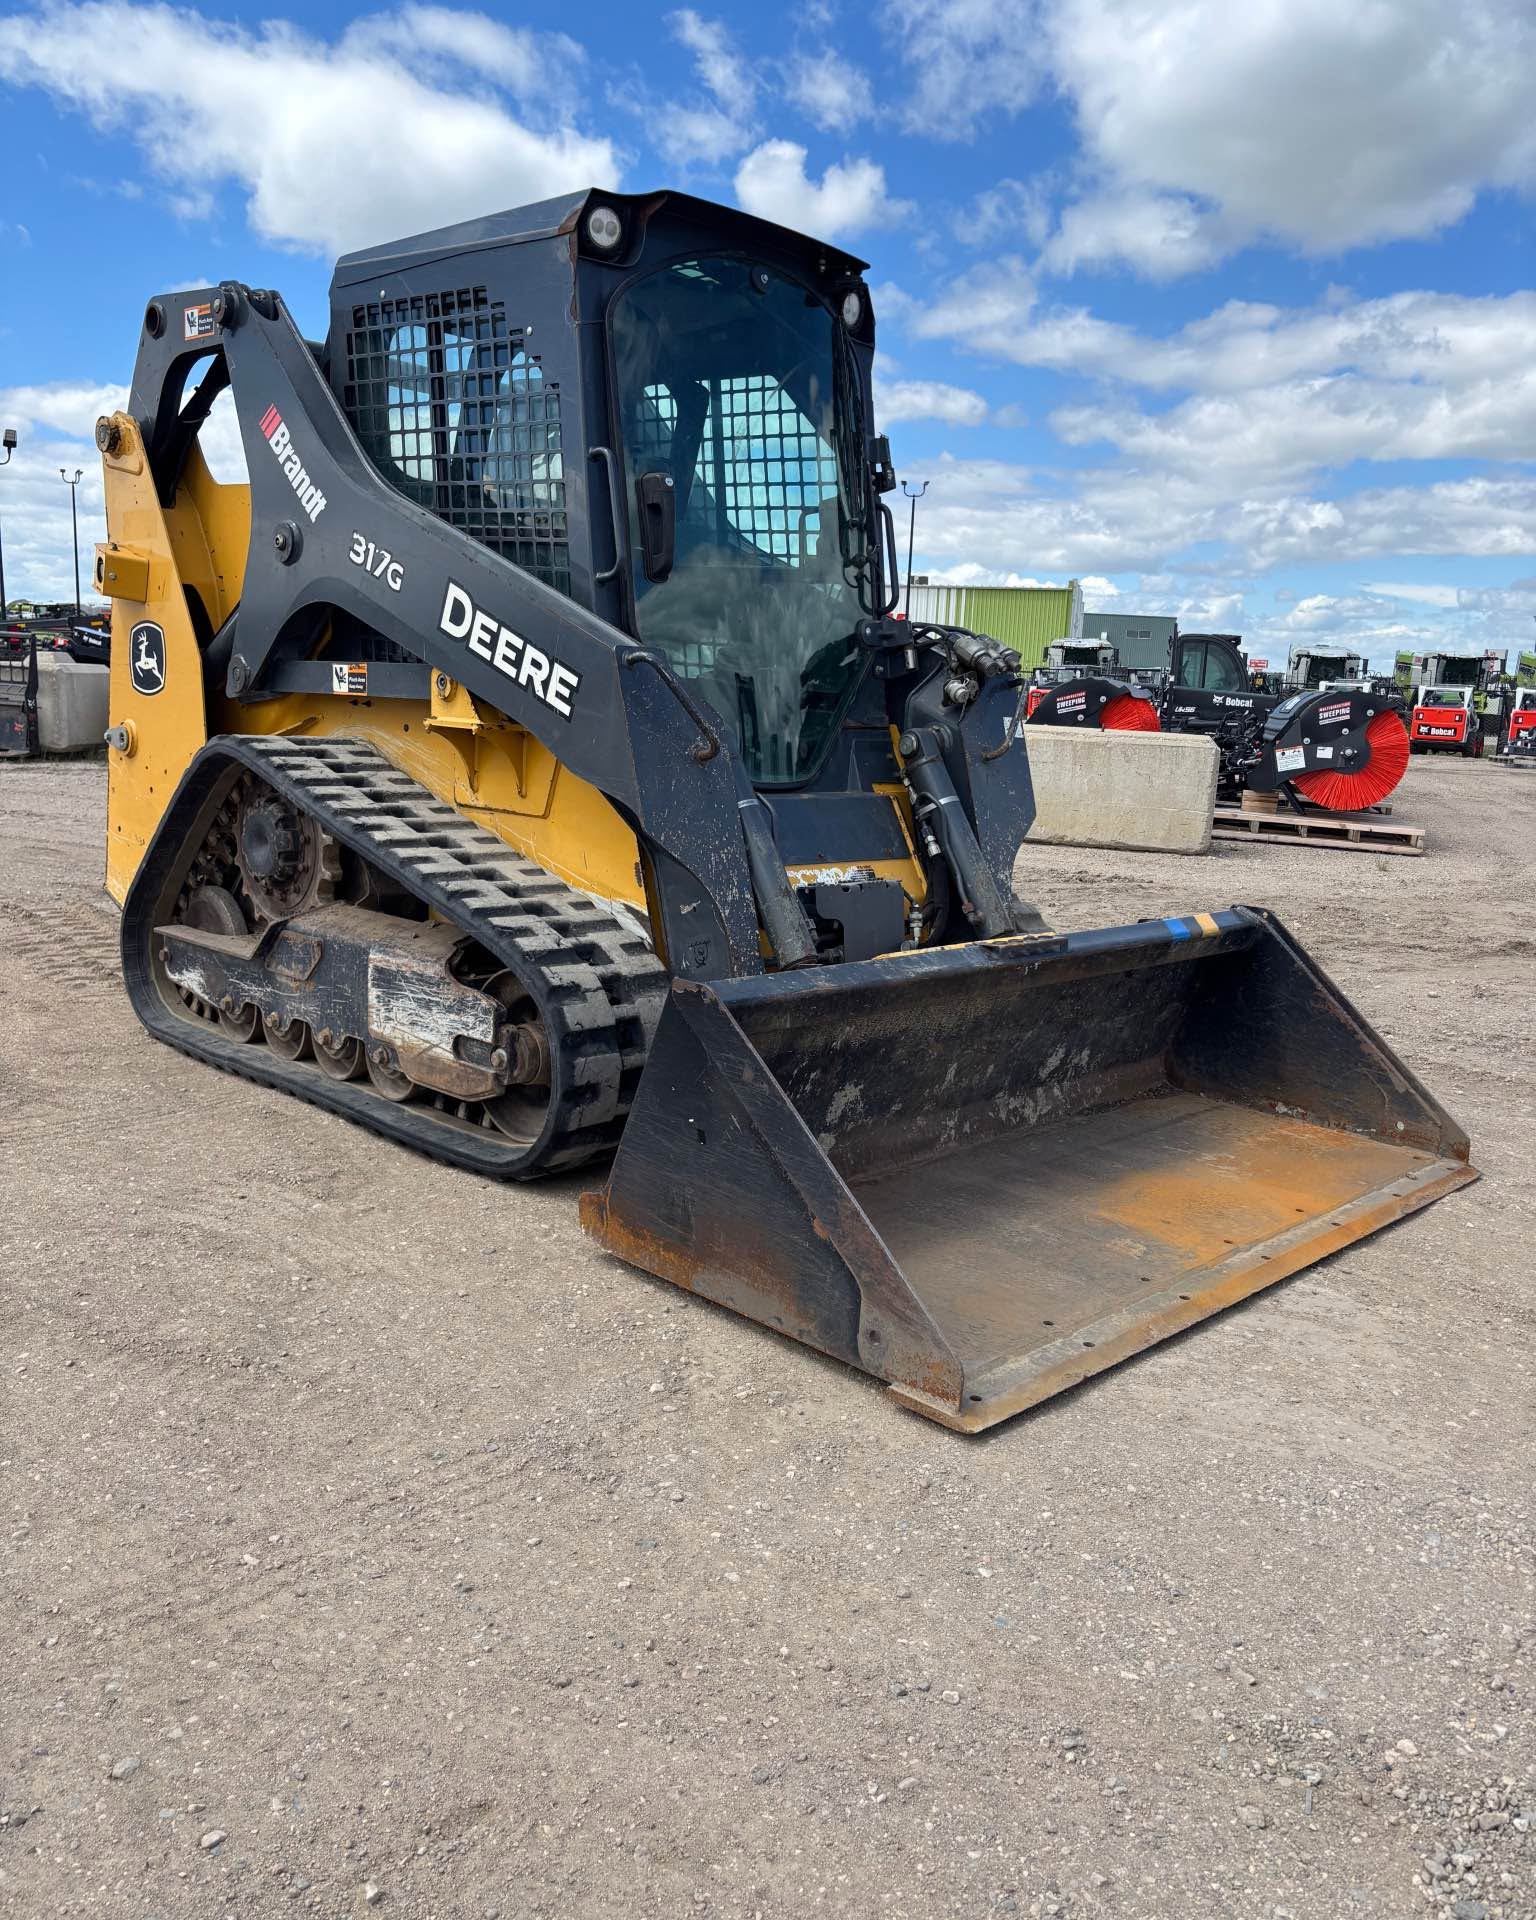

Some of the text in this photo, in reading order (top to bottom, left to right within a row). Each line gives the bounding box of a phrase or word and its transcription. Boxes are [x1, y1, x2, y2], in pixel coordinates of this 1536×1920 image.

[268, 421, 327, 523] Brandt
[349, 530, 405, 591] 317G
[440, 582, 579, 717] DEERE
[1056, 696, 1086, 709] SWEEPING
[1225, 697, 1254, 708] Bobcat
[1319, 707, 1351, 720] SWEEPING
[1430, 727, 1456, 736] Bobcat
